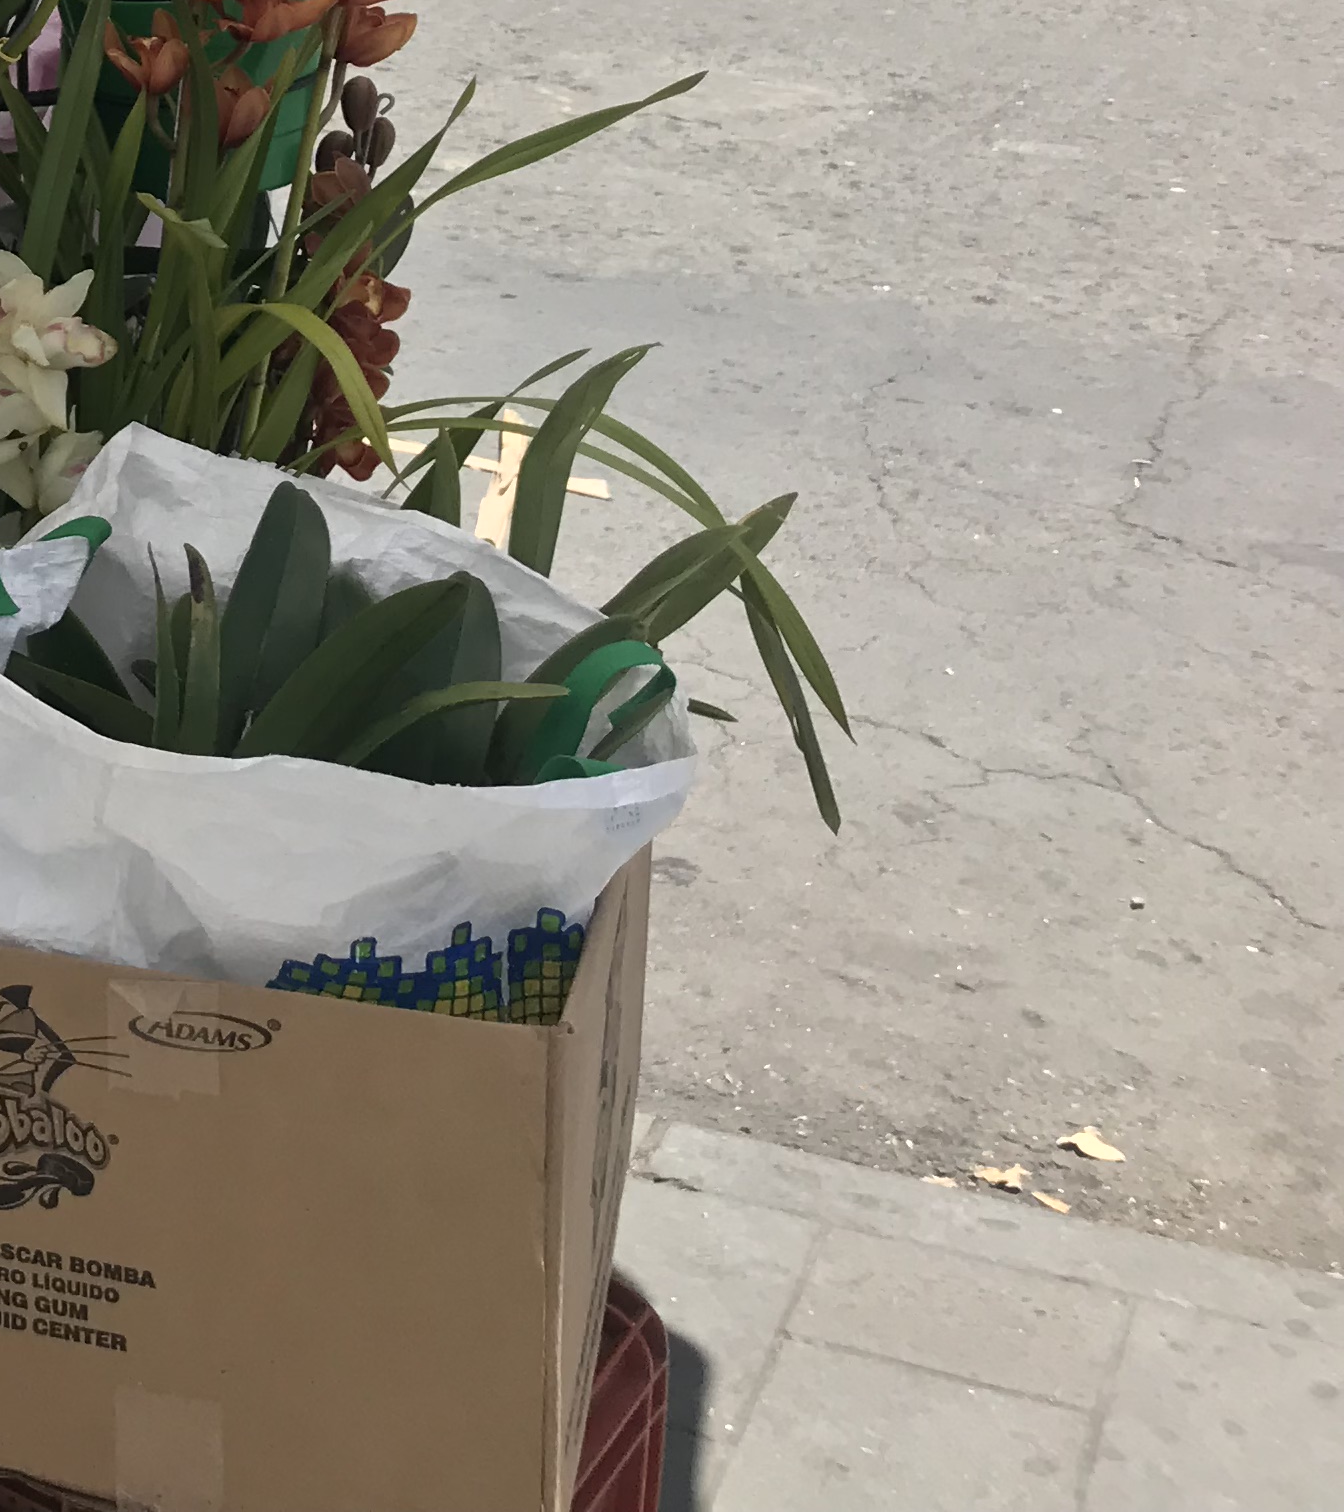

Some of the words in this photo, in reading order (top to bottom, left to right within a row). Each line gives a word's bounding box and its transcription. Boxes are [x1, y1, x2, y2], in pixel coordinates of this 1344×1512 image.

[148, 1018, 253, 1052] ADAMS
[69, 1256, 157, 1289] BOMBA
[34, 1296, 89, 1321] GUM
[32, 1318, 128, 1352] CENTER
